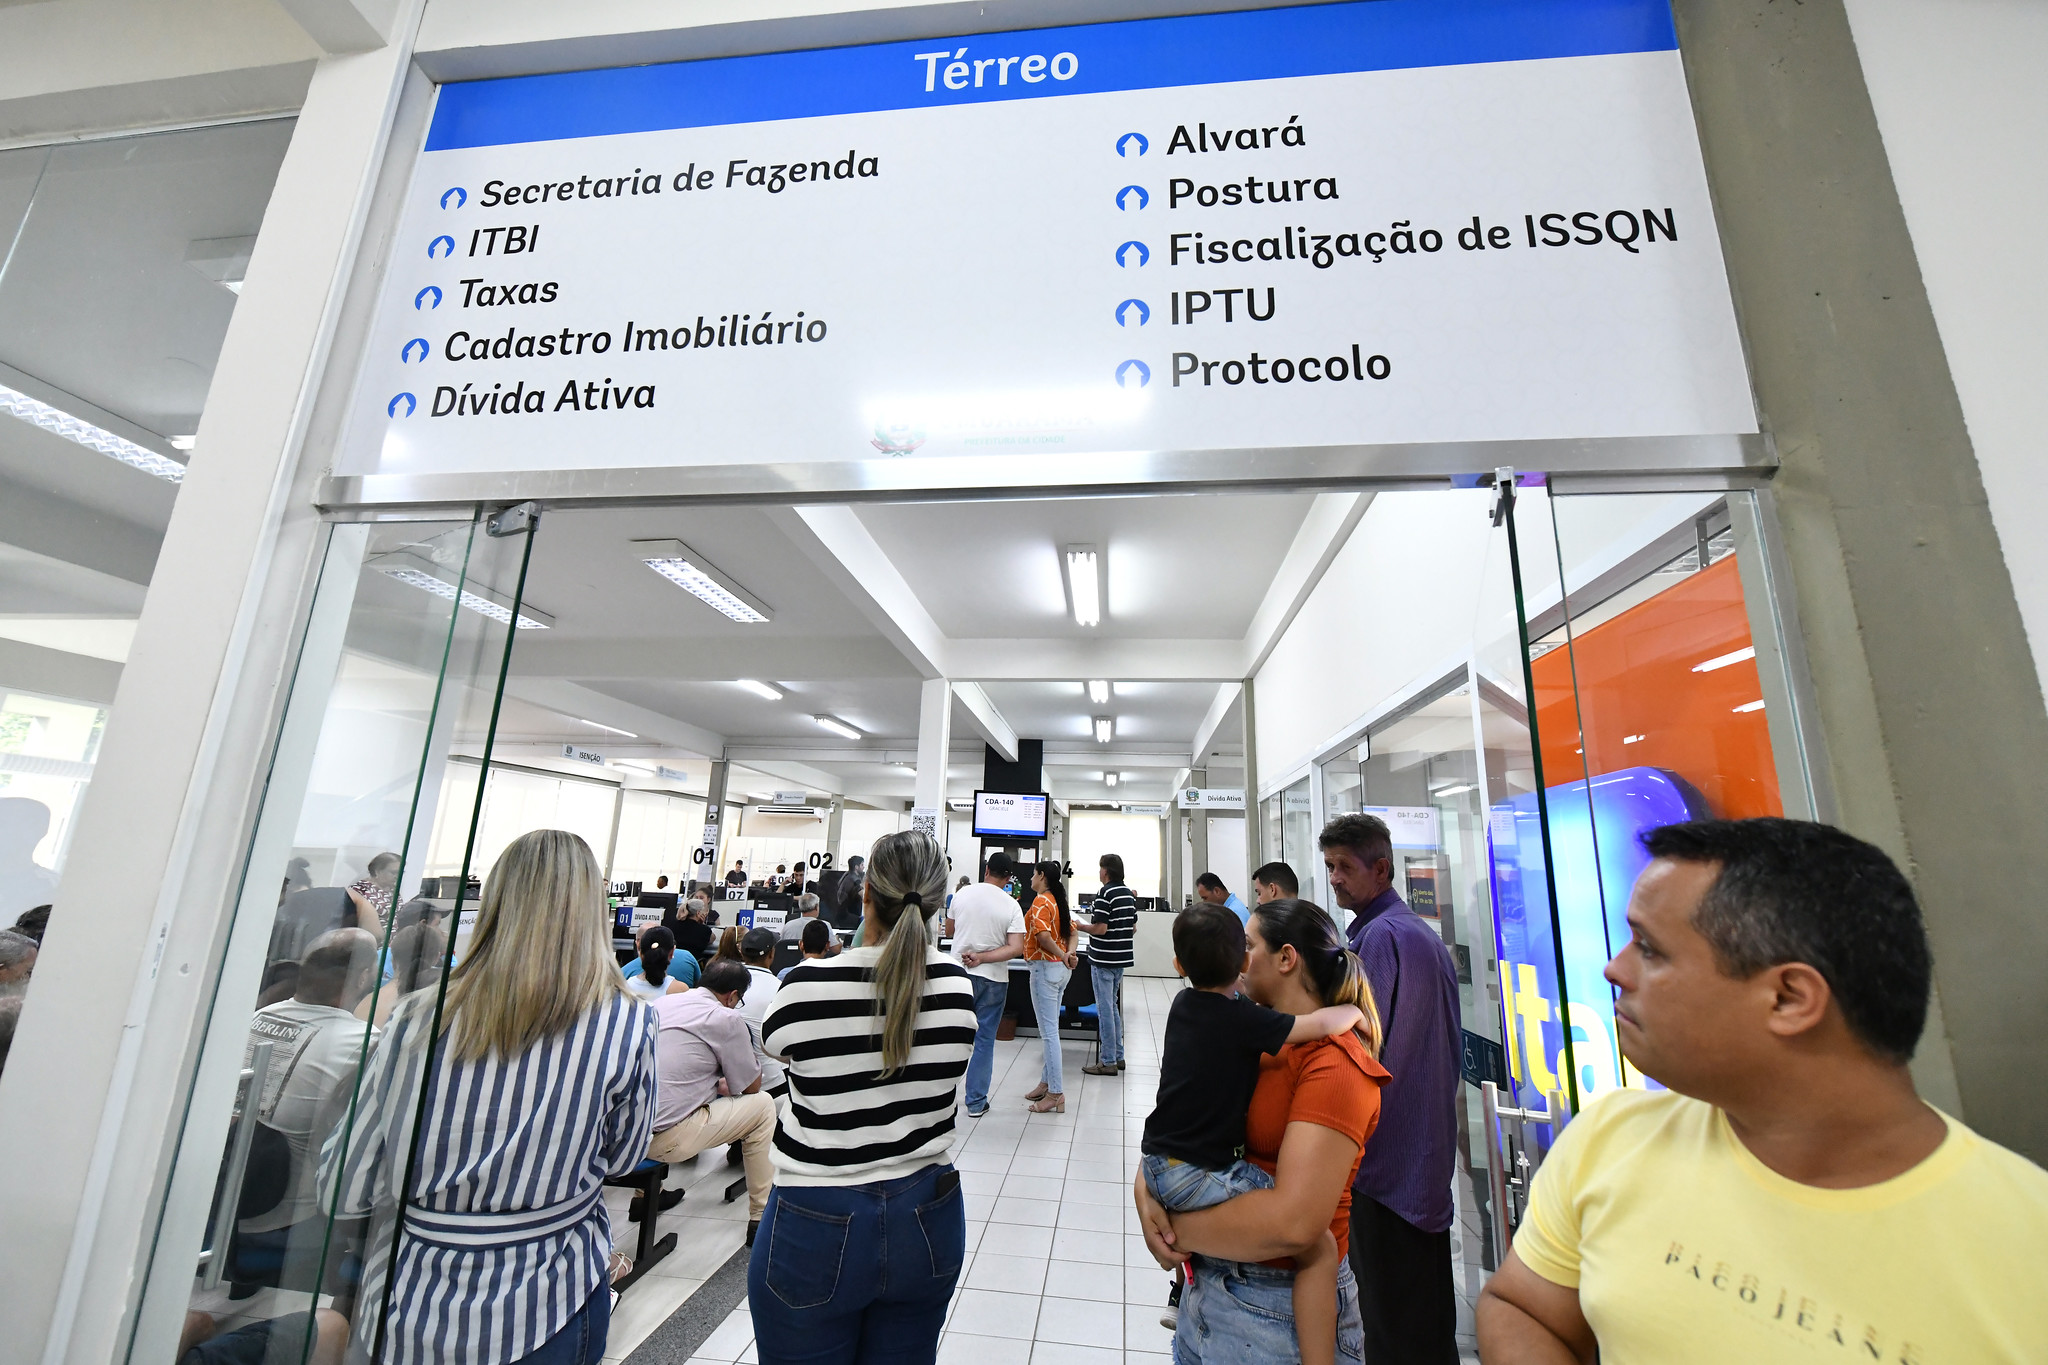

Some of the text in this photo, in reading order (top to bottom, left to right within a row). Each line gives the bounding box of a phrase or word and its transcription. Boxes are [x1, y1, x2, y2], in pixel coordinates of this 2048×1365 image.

[914, 47, 1080, 93] Térreo
[1166, 114, 1306, 156] Alvará
[479, 149, 879, 208] Secretaria de Fazenda
[1169, 176, 1340, 209] Postura
[468, 224, 540, 258] ITBI
[1170, 207, 1678, 270] Fiscalização de ISSQN
[459, 278, 559, 308] Taxas
[1171, 287, 1276, 325] IPTU
[444, 311, 827, 362] Cadastro Imobiliário
[1172, 343, 1391, 387] Protocolo
[430, 377, 656, 418] Dívida Ativa
[963, 434, 1066, 446] PREFEITURA DA CIDADE
[579, 751, 601, 763] ISENÇÃO
[984, 798, 1015, 806] CDA-140
[693, 847, 715, 866] 01
[809, 852, 833, 870] 02
[614, 883, 626, 891] 10
[728, 890, 745, 900] 07
[619, 913, 629, 924] 01
[741, 916, 751, 927] 02
[1499, 957, 1665, 1115] Ita
[1664, 1240, 1759, 1304] PACO
